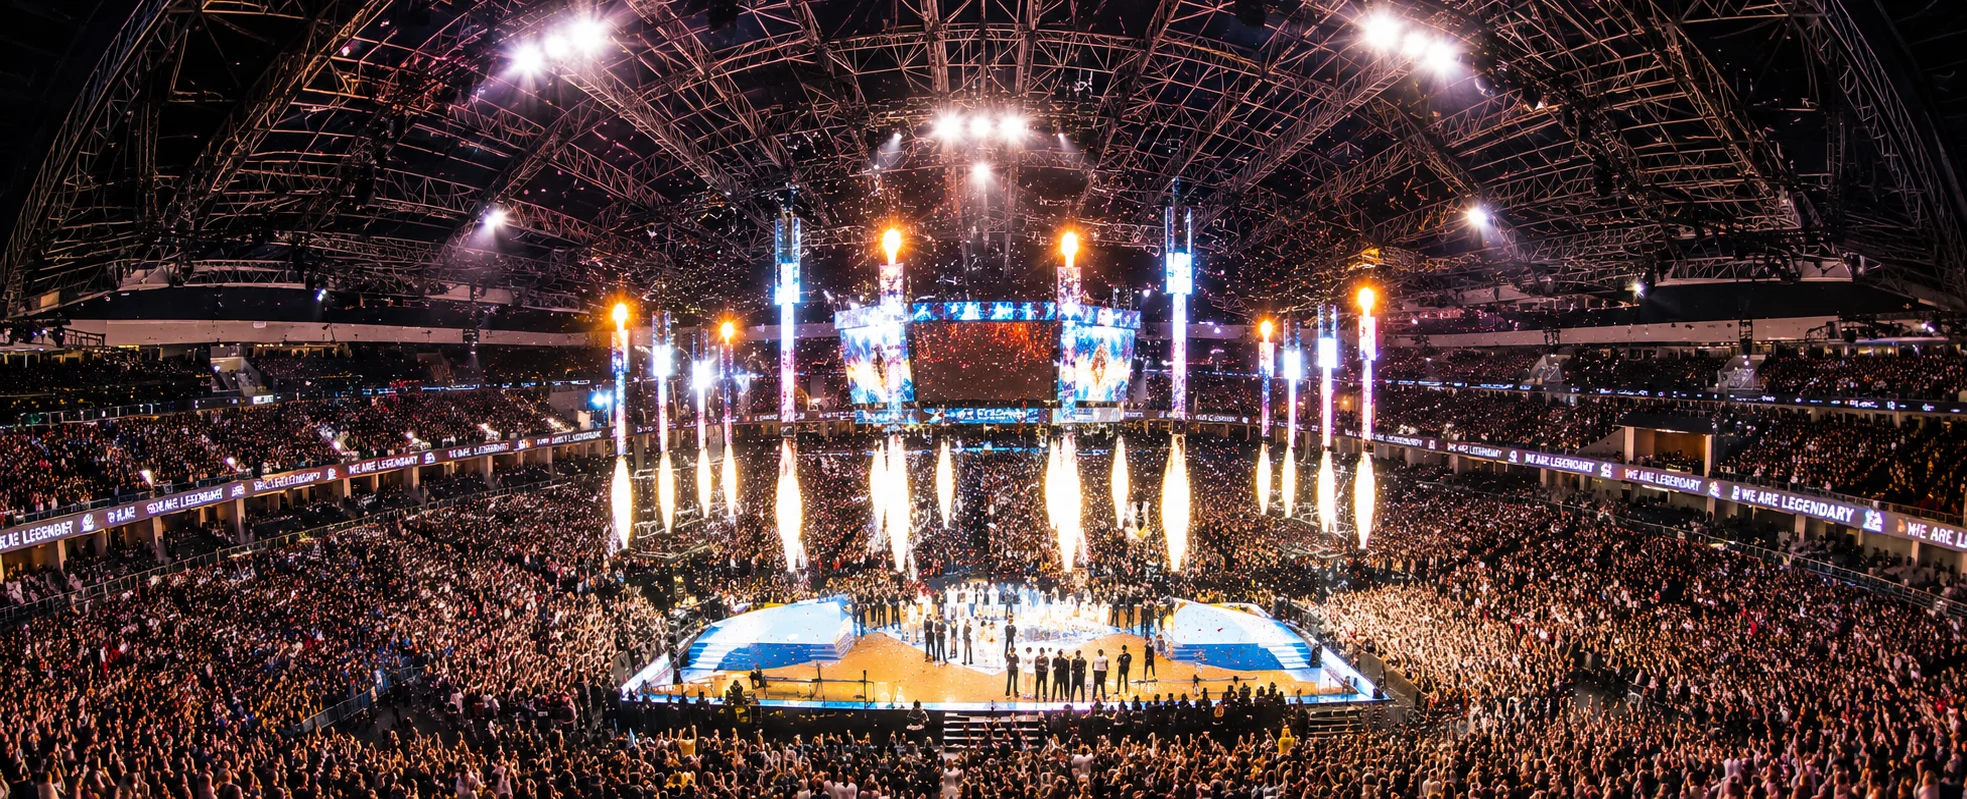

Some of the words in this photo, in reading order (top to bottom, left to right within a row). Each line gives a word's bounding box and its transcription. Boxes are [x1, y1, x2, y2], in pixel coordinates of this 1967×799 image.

[1741, 488, 1756, 503] WE
[1758, 491, 1779, 507] ARE
[1781, 495, 1855, 523] LEGENDARY
[1930, 526, 1954, 546] ARE
[1956, 531, 1967, 549] L
